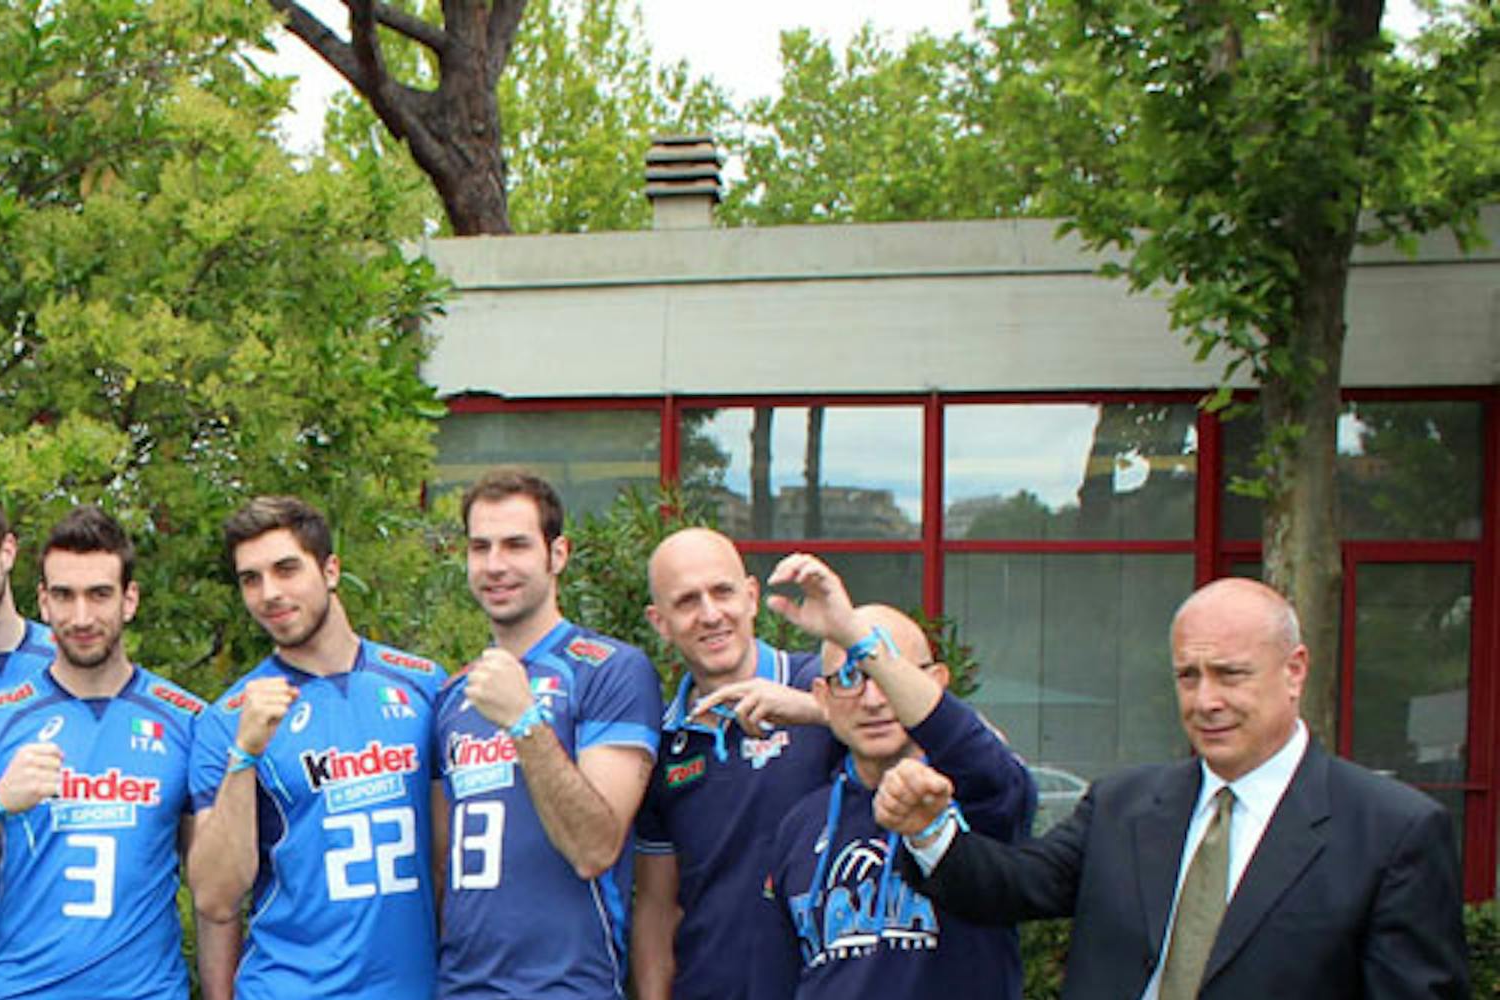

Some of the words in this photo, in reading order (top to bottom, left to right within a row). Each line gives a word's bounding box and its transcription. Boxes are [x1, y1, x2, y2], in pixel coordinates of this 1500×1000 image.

[380, 705, 417, 720] ITA
[131, 736, 166, 754] ITA
[303, 743, 416, 790] Kinder
[53, 769, 156, 803] inder
[322, 806, 420, 902] 22
[452, 802, 505, 891] 13
[61, 834, 116, 919] 3
